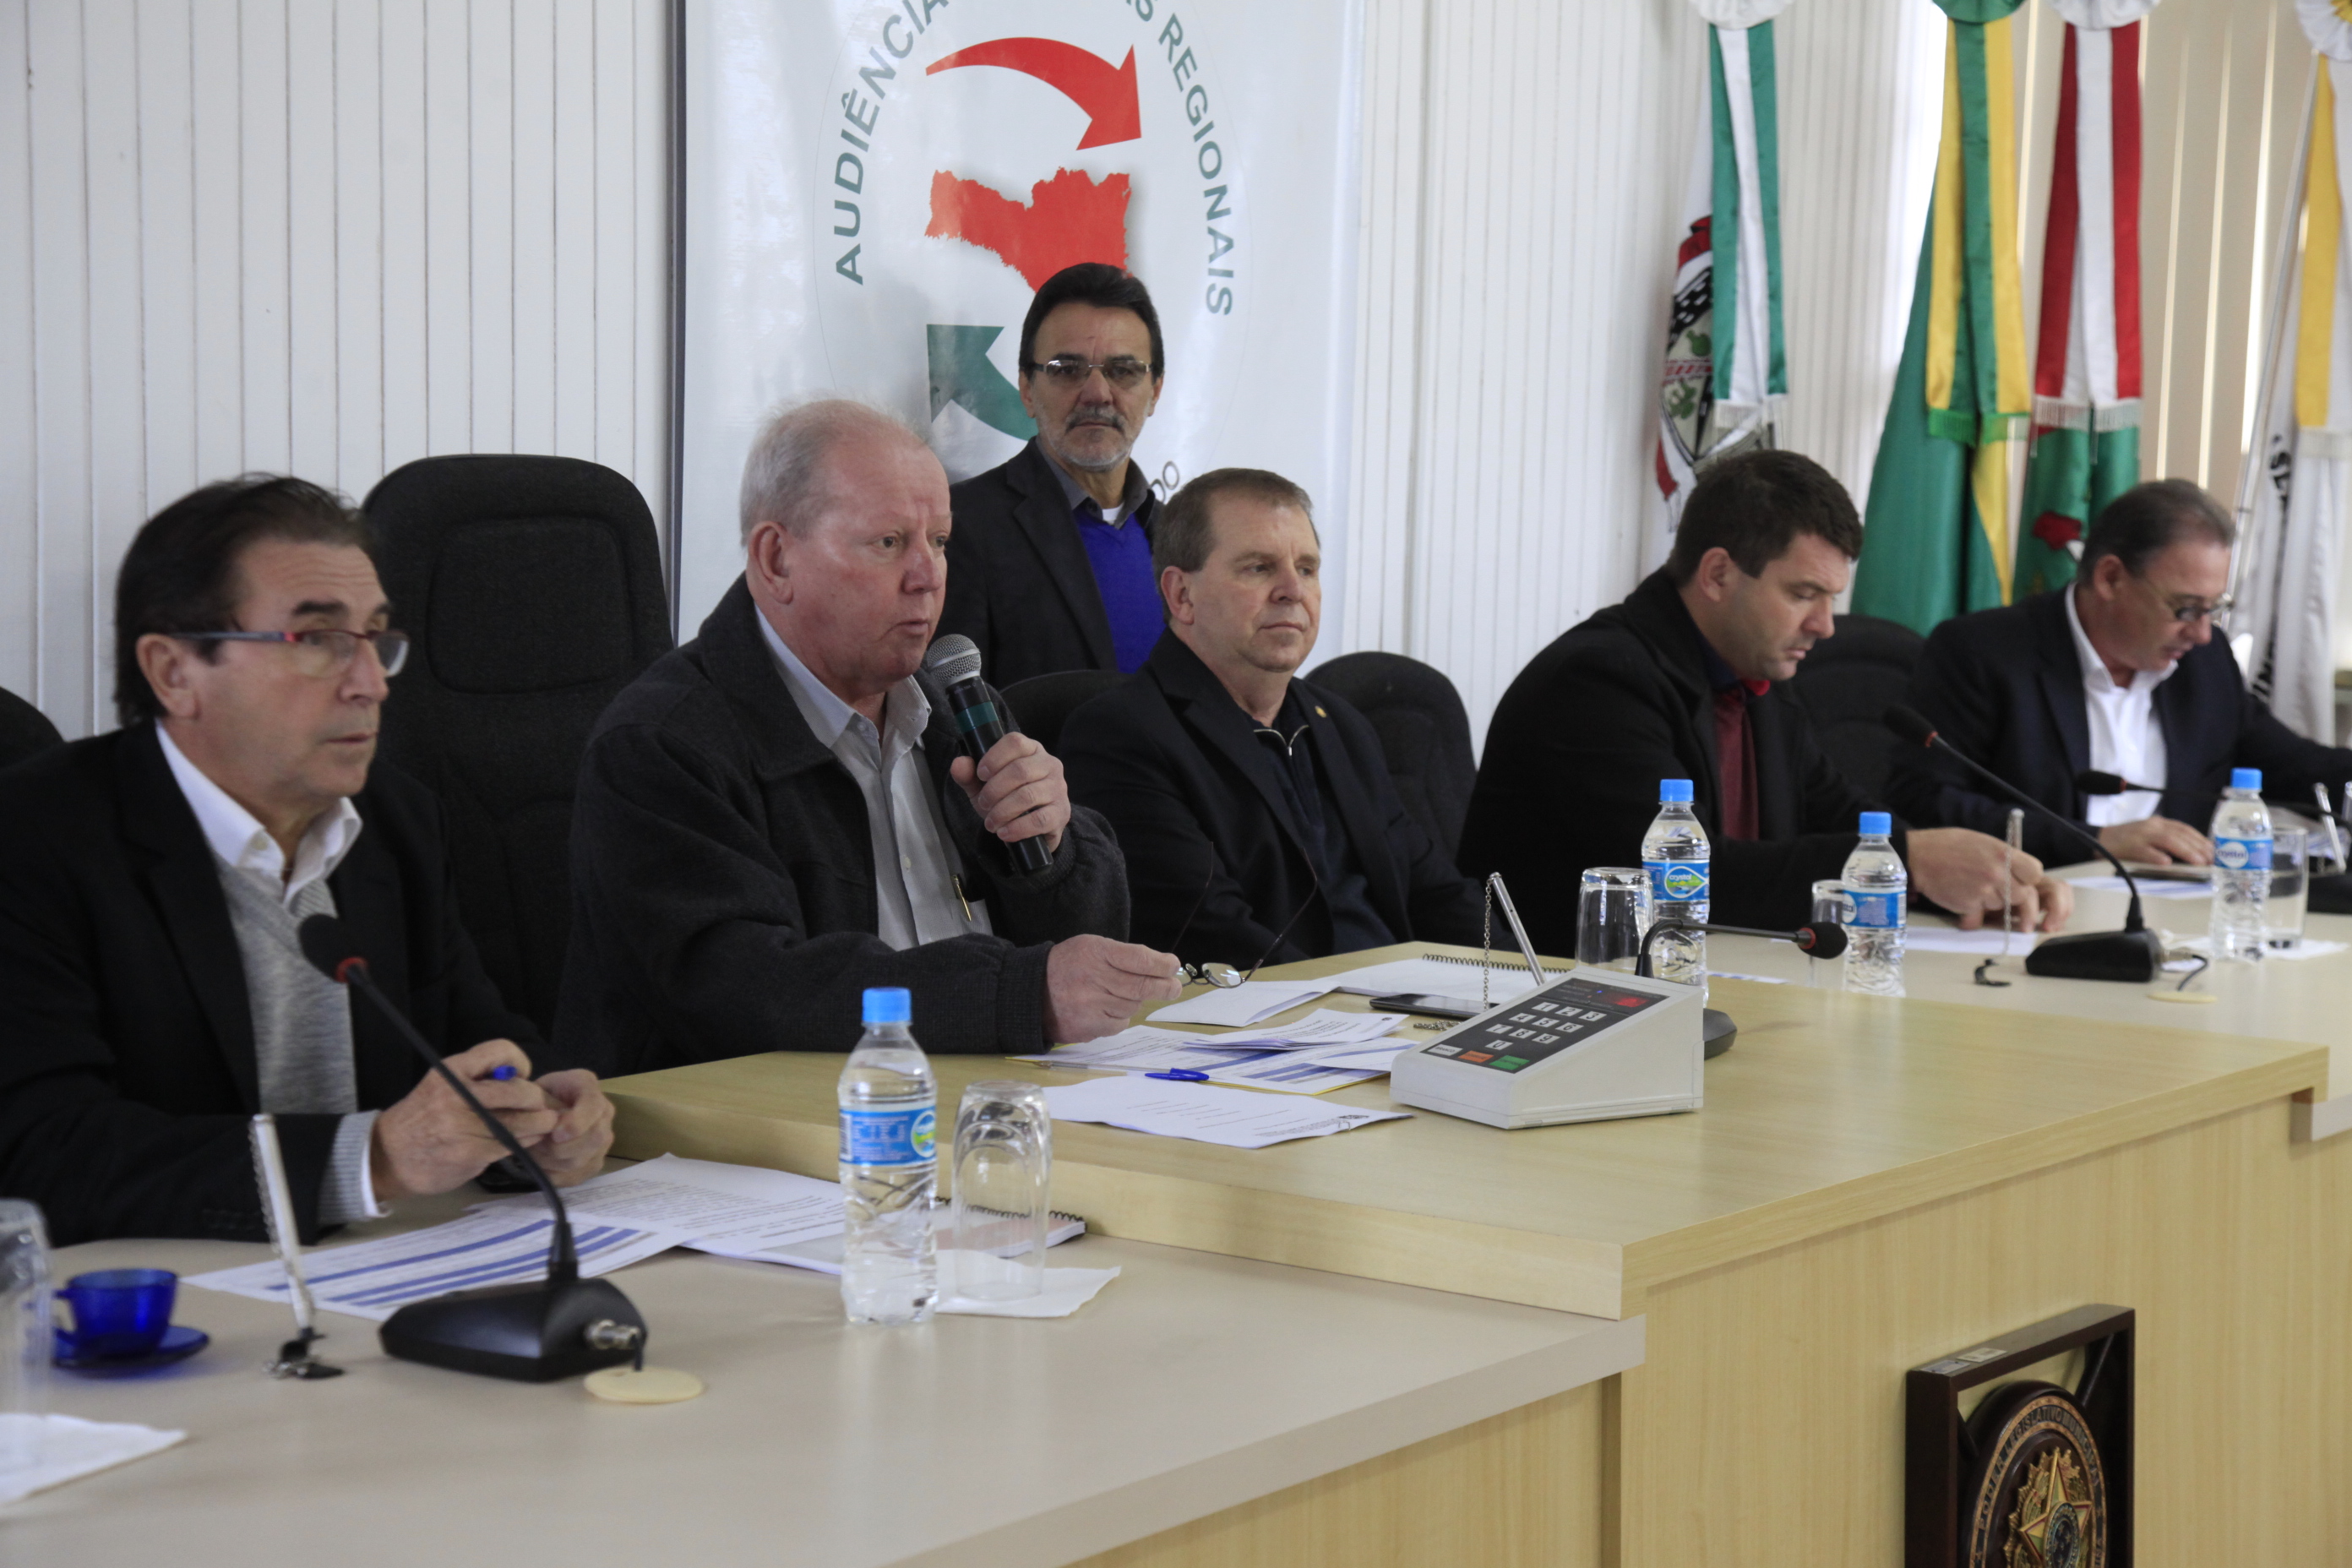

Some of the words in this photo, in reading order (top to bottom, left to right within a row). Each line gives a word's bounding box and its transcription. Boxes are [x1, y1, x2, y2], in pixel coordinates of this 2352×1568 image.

[1158, 13, 1233, 315] REGIONAIS
[1979, 1455, 2006, 1530] PODER
[2004, 1407, 2062, 1451] LEGISLATIVO
